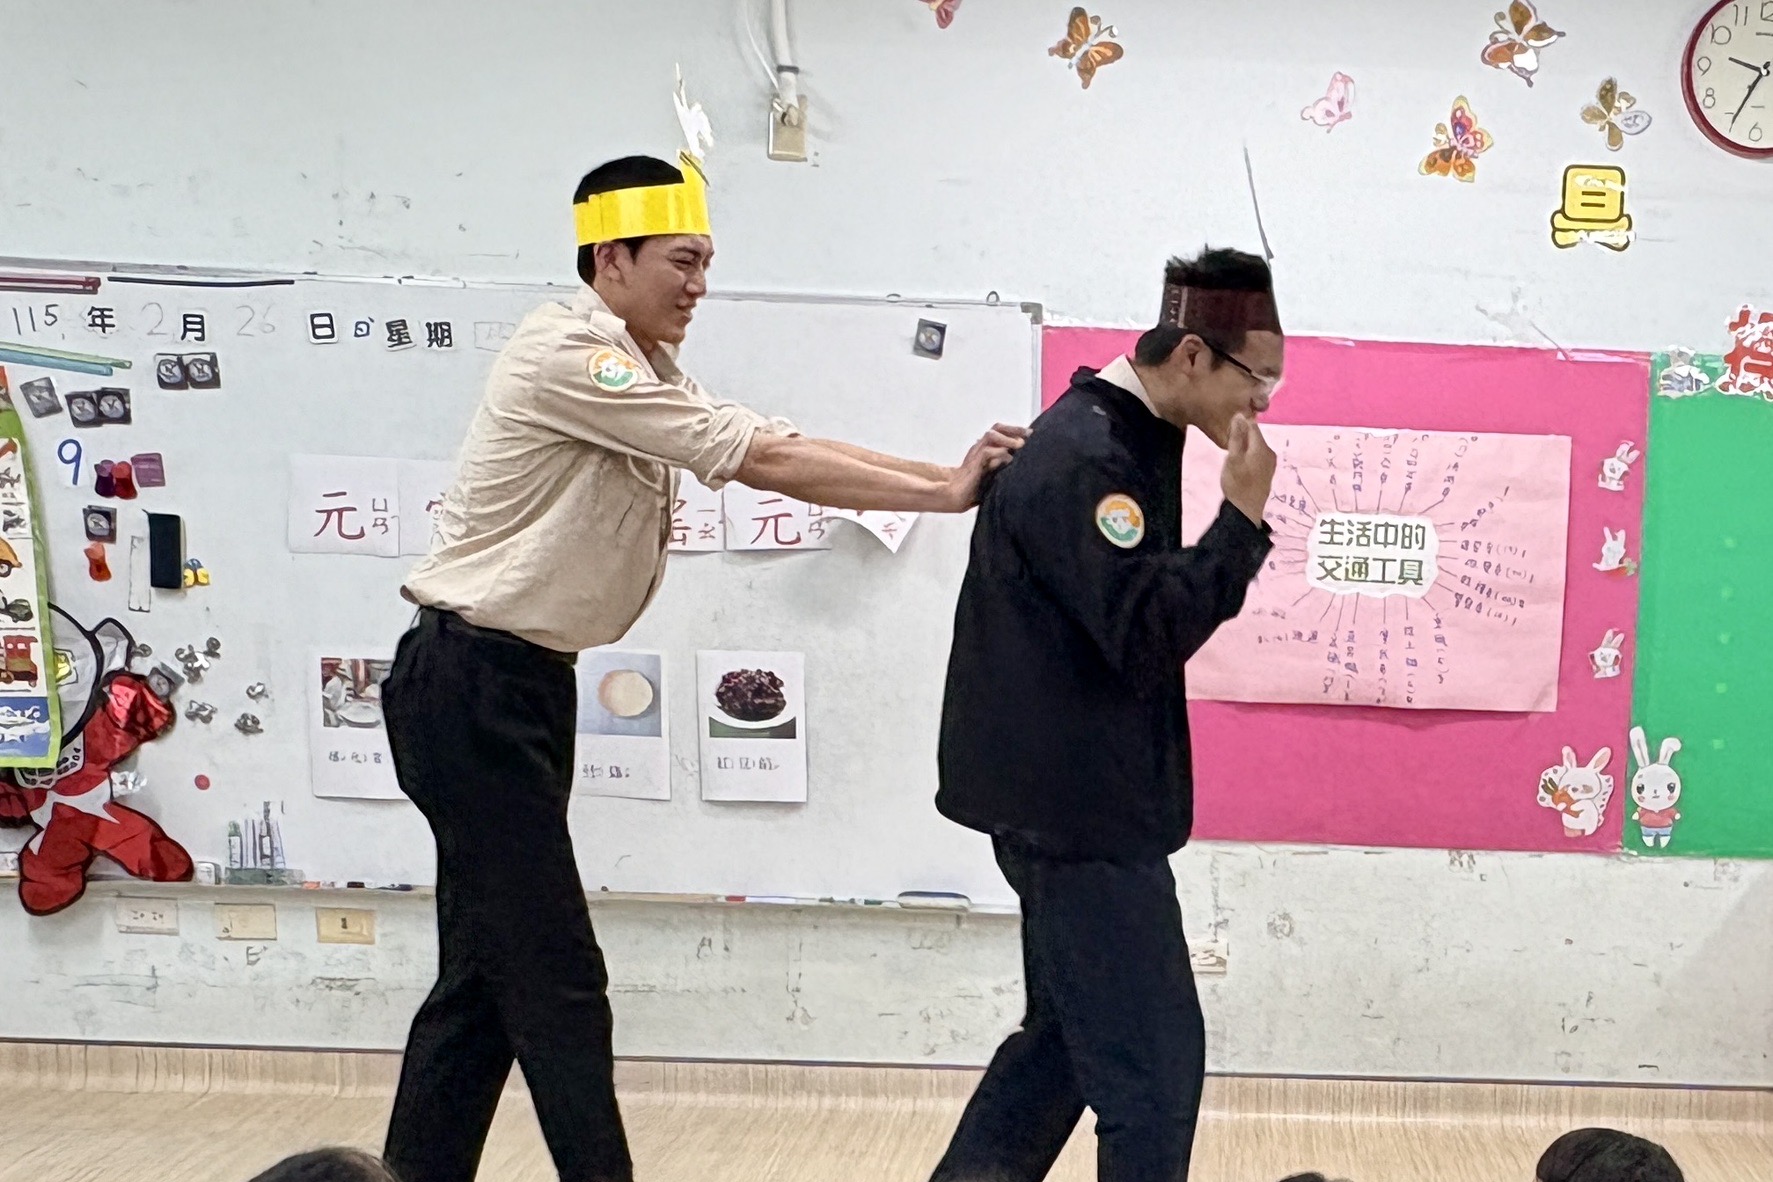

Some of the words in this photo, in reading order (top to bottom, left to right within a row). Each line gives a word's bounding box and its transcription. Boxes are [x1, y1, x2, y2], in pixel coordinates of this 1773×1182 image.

[1733, 4, 1748, 26] 11
[1710, 22, 1732, 45] 10
[1697, 56, 1711, 76] 9
[1703, 87, 1716, 109] 8
[1749, 121, 1763, 142] 6
[12, 304, 59, 335] 115
[87, 306, 116, 334] 年
[141, 302, 168, 336] 2
[181, 313, 206, 342] 月
[309, 312, 336, 340] 日
[57, 438, 83, 486] 9
[313, 491, 366, 540] 元
[751, 498, 802, 545] 元
[1318, 518, 1427, 551] 生活中的
[1317, 555, 1423, 586] 交通工具
